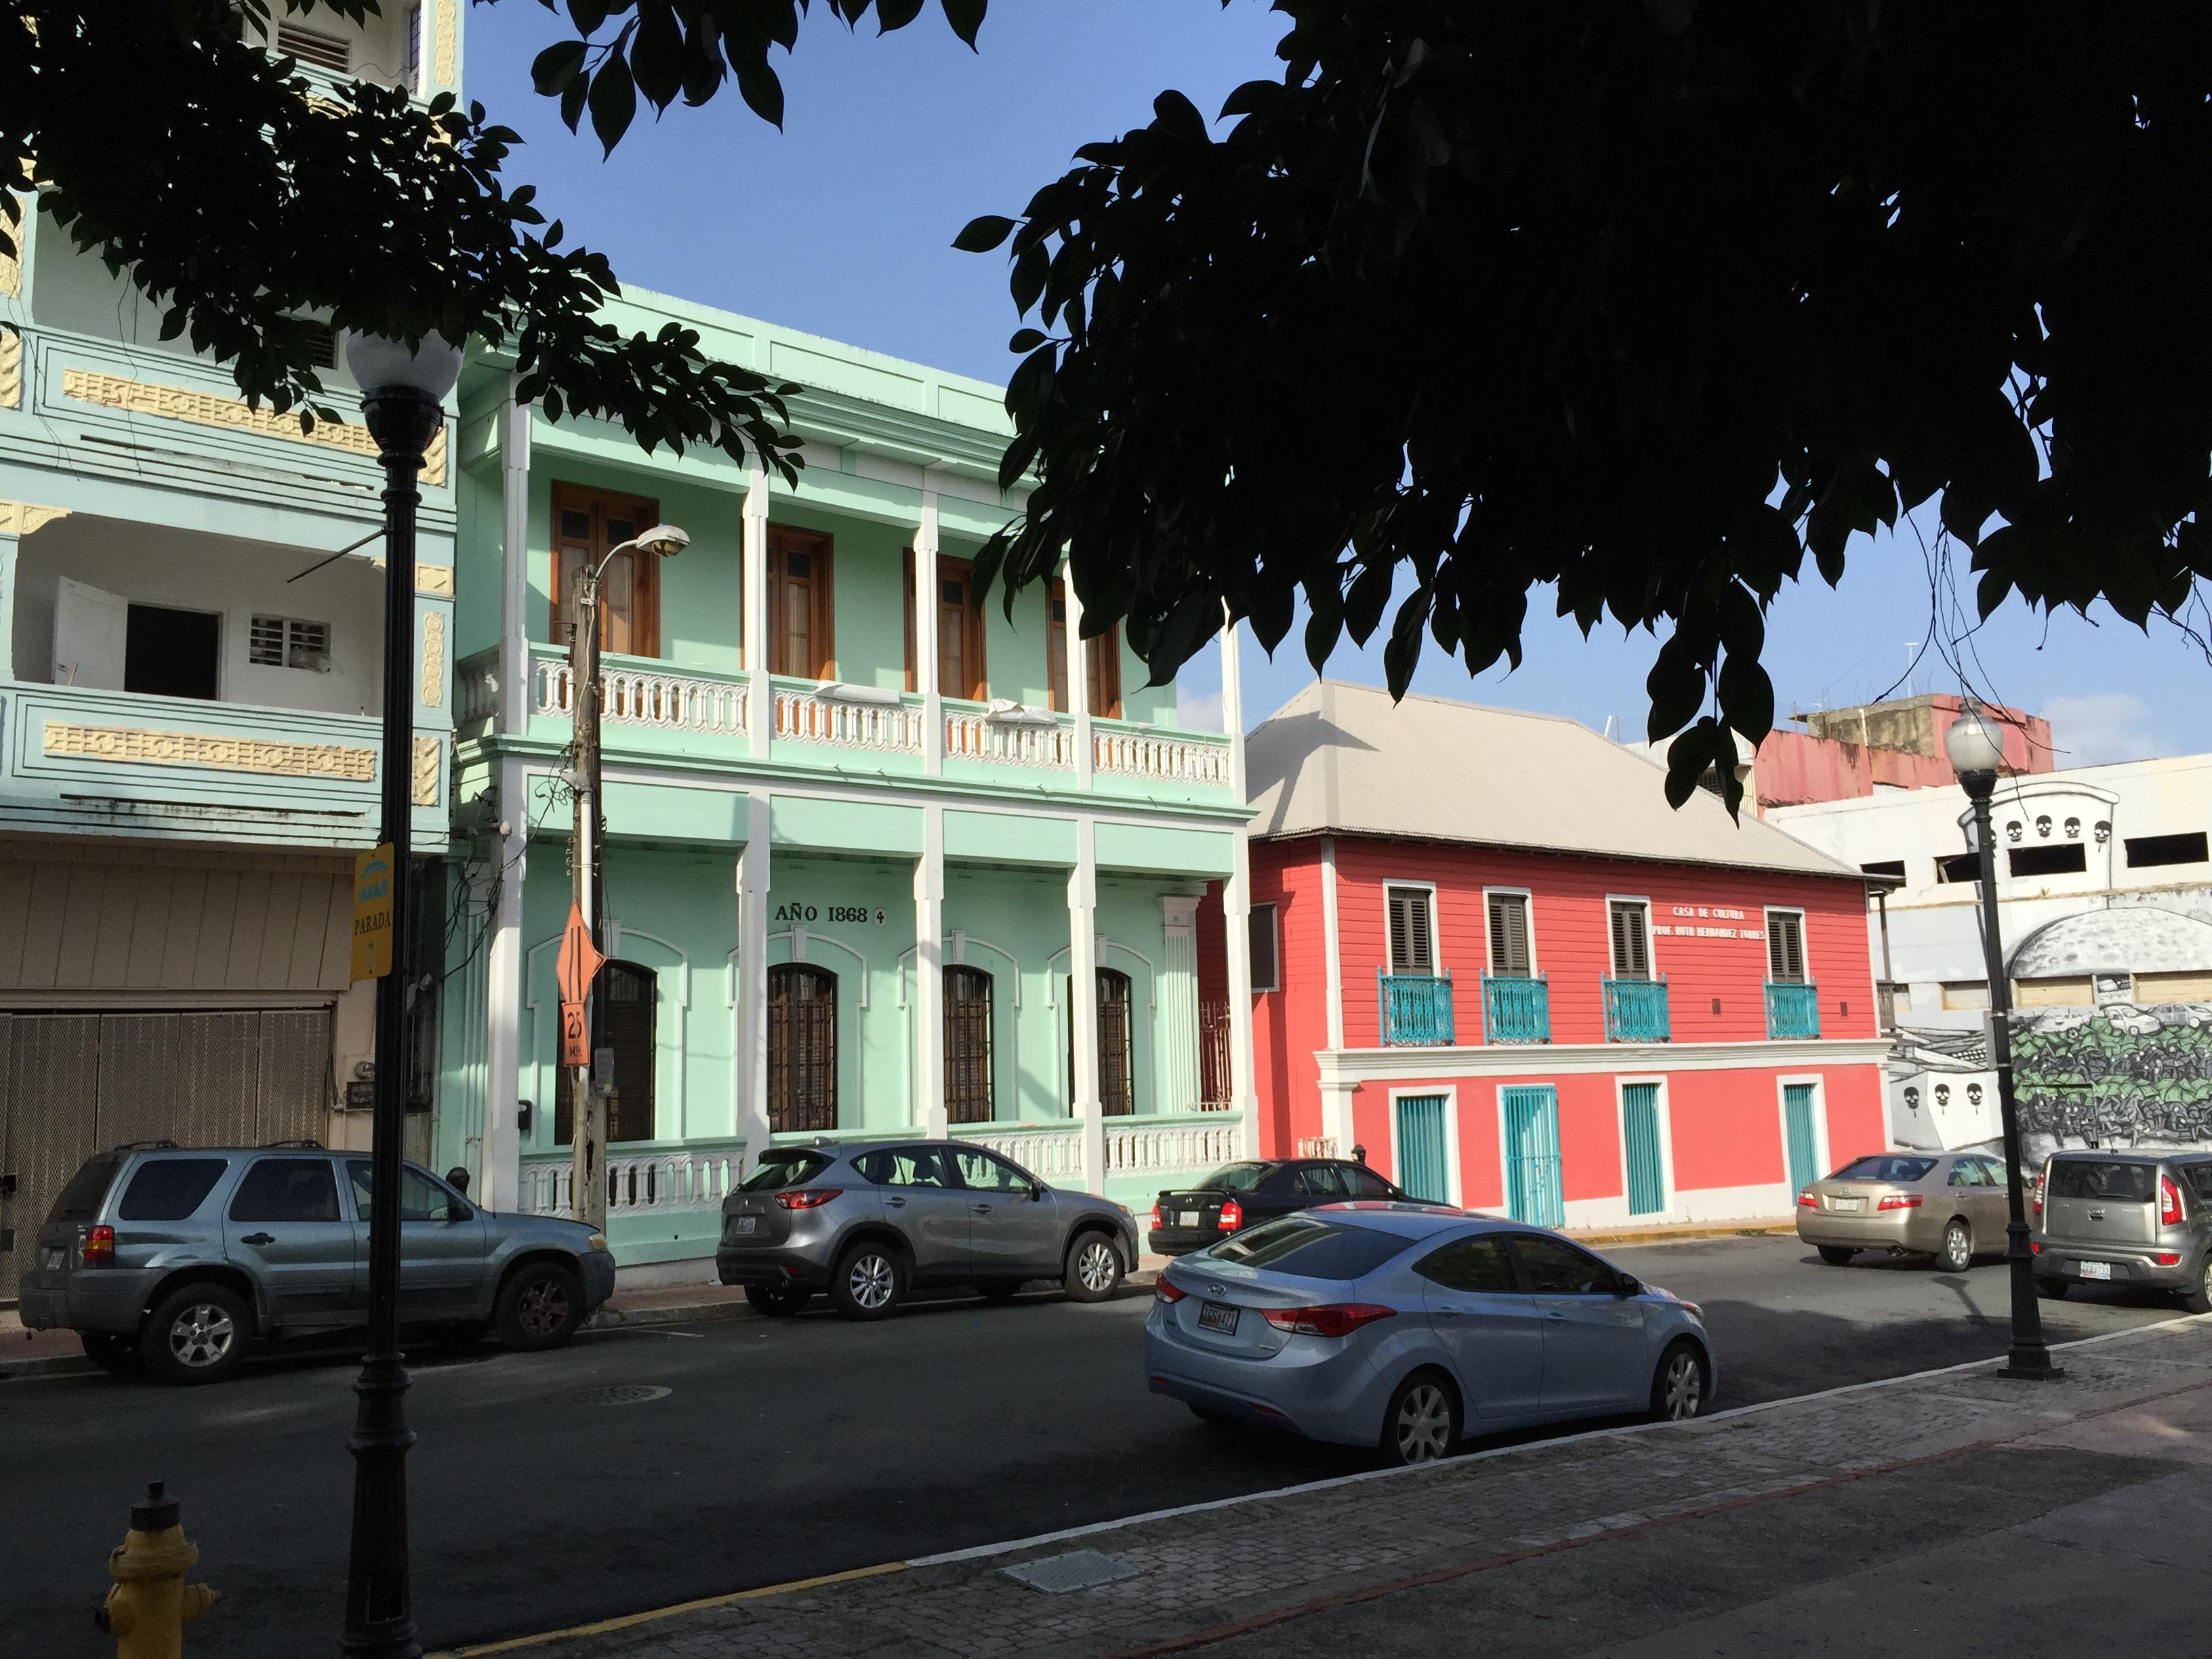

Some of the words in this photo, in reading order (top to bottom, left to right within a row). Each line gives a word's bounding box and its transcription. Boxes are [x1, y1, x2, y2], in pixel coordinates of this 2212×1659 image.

[775, 903, 817, 921] AÑO
[828, 907, 867, 922] 1868
[876, 911, 884, 924] 4
[1673, 906, 1694, 918] CASA
[1698, 907, 1708, 918] DE
[1713, 909, 1745, 920] CULTURA
[354, 910, 391, 936] PARADA
[1652, 924, 1674, 935] PROF.
[1675, 926, 1694, 937] RUTH
[1739, 928, 1765, 941] TORRES
[567, 1012, 582, 1040] 25
